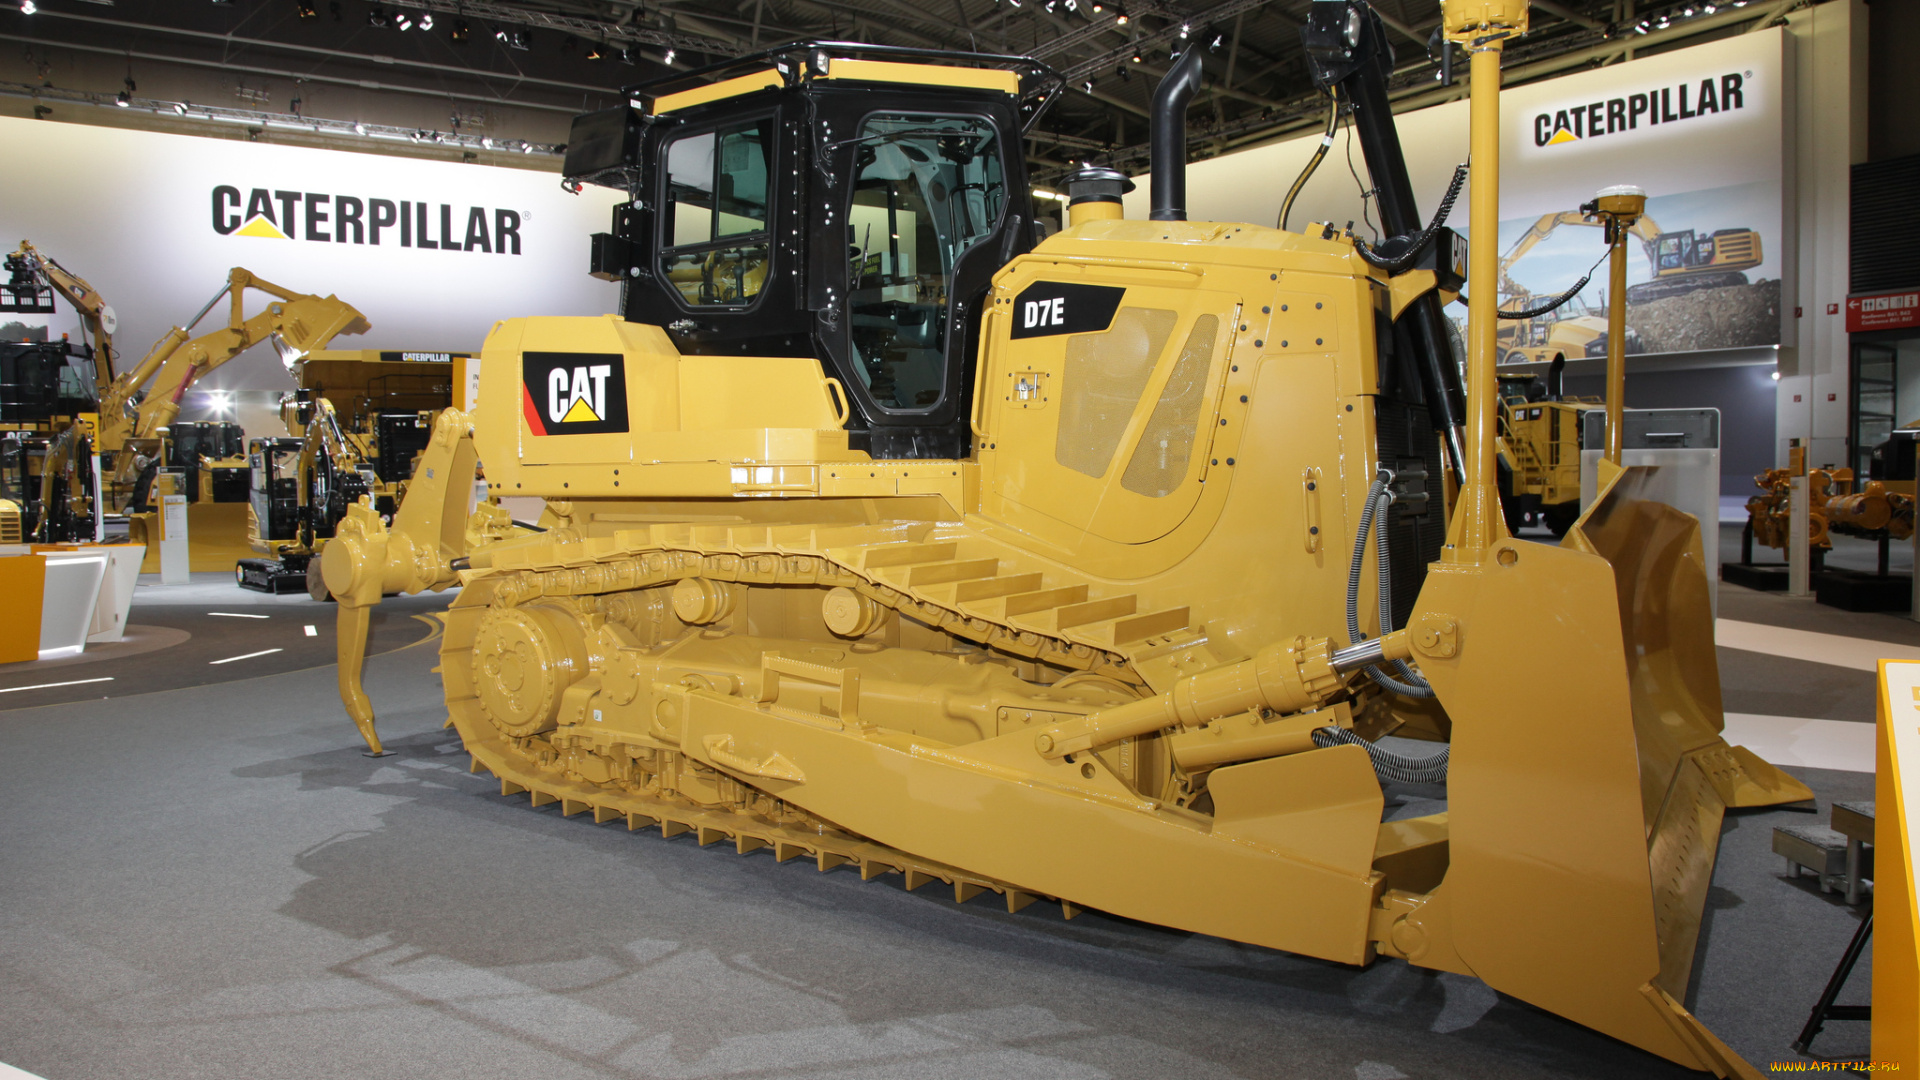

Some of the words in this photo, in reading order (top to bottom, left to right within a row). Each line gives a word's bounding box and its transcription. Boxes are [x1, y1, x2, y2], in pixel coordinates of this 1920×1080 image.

[1534, 72, 1743, 147] CATERPILLAR
[211, 184, 522, 256] CATERPILLAR
[1024, 297, 1064, 328] D7E
[402, 352, 450, 362] CATERPILLAR
[548, 364, 611, 423] CAT
